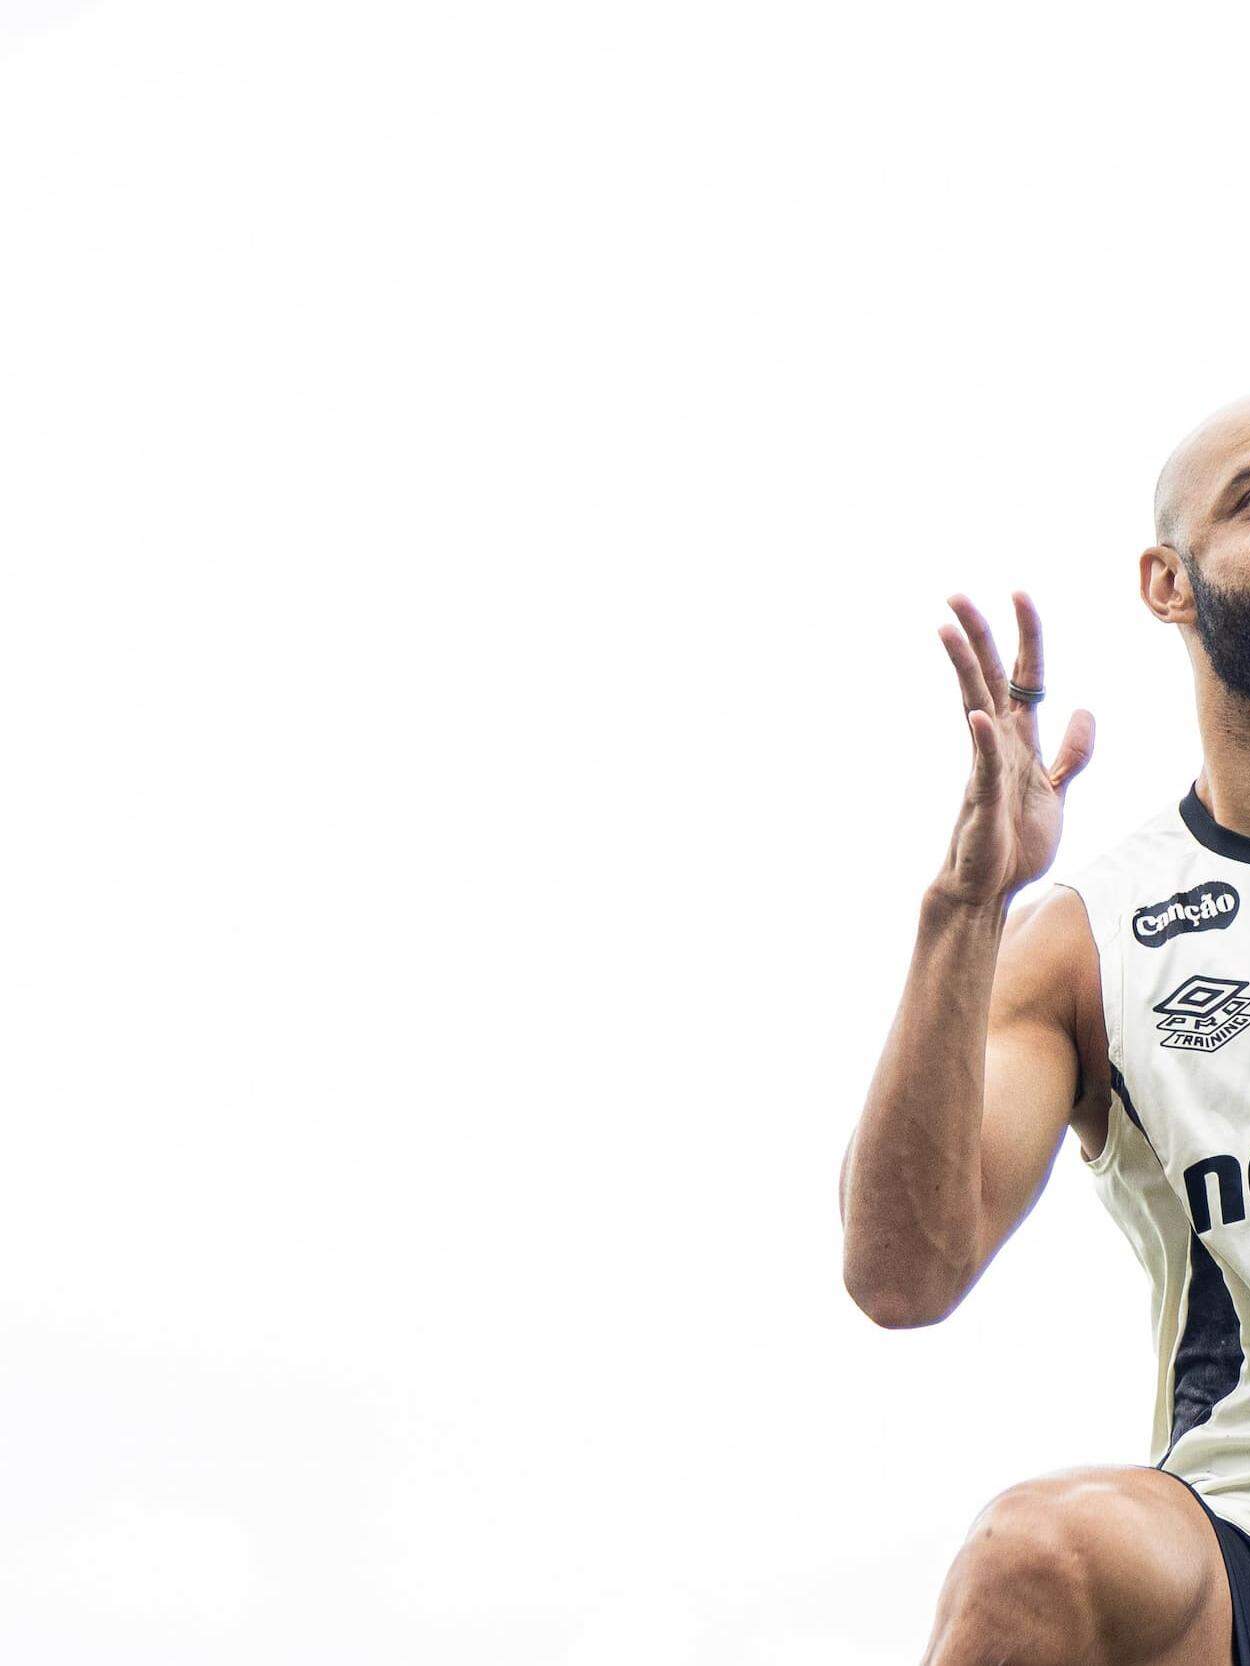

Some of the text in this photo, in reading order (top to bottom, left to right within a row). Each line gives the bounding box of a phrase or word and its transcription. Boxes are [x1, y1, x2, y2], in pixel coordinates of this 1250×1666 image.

[1136, 893, 1235, 936] Canção
[1165, 1000, 1246, 1030] PRO
[1174, 1017, 1248, 1048] TRAINING
